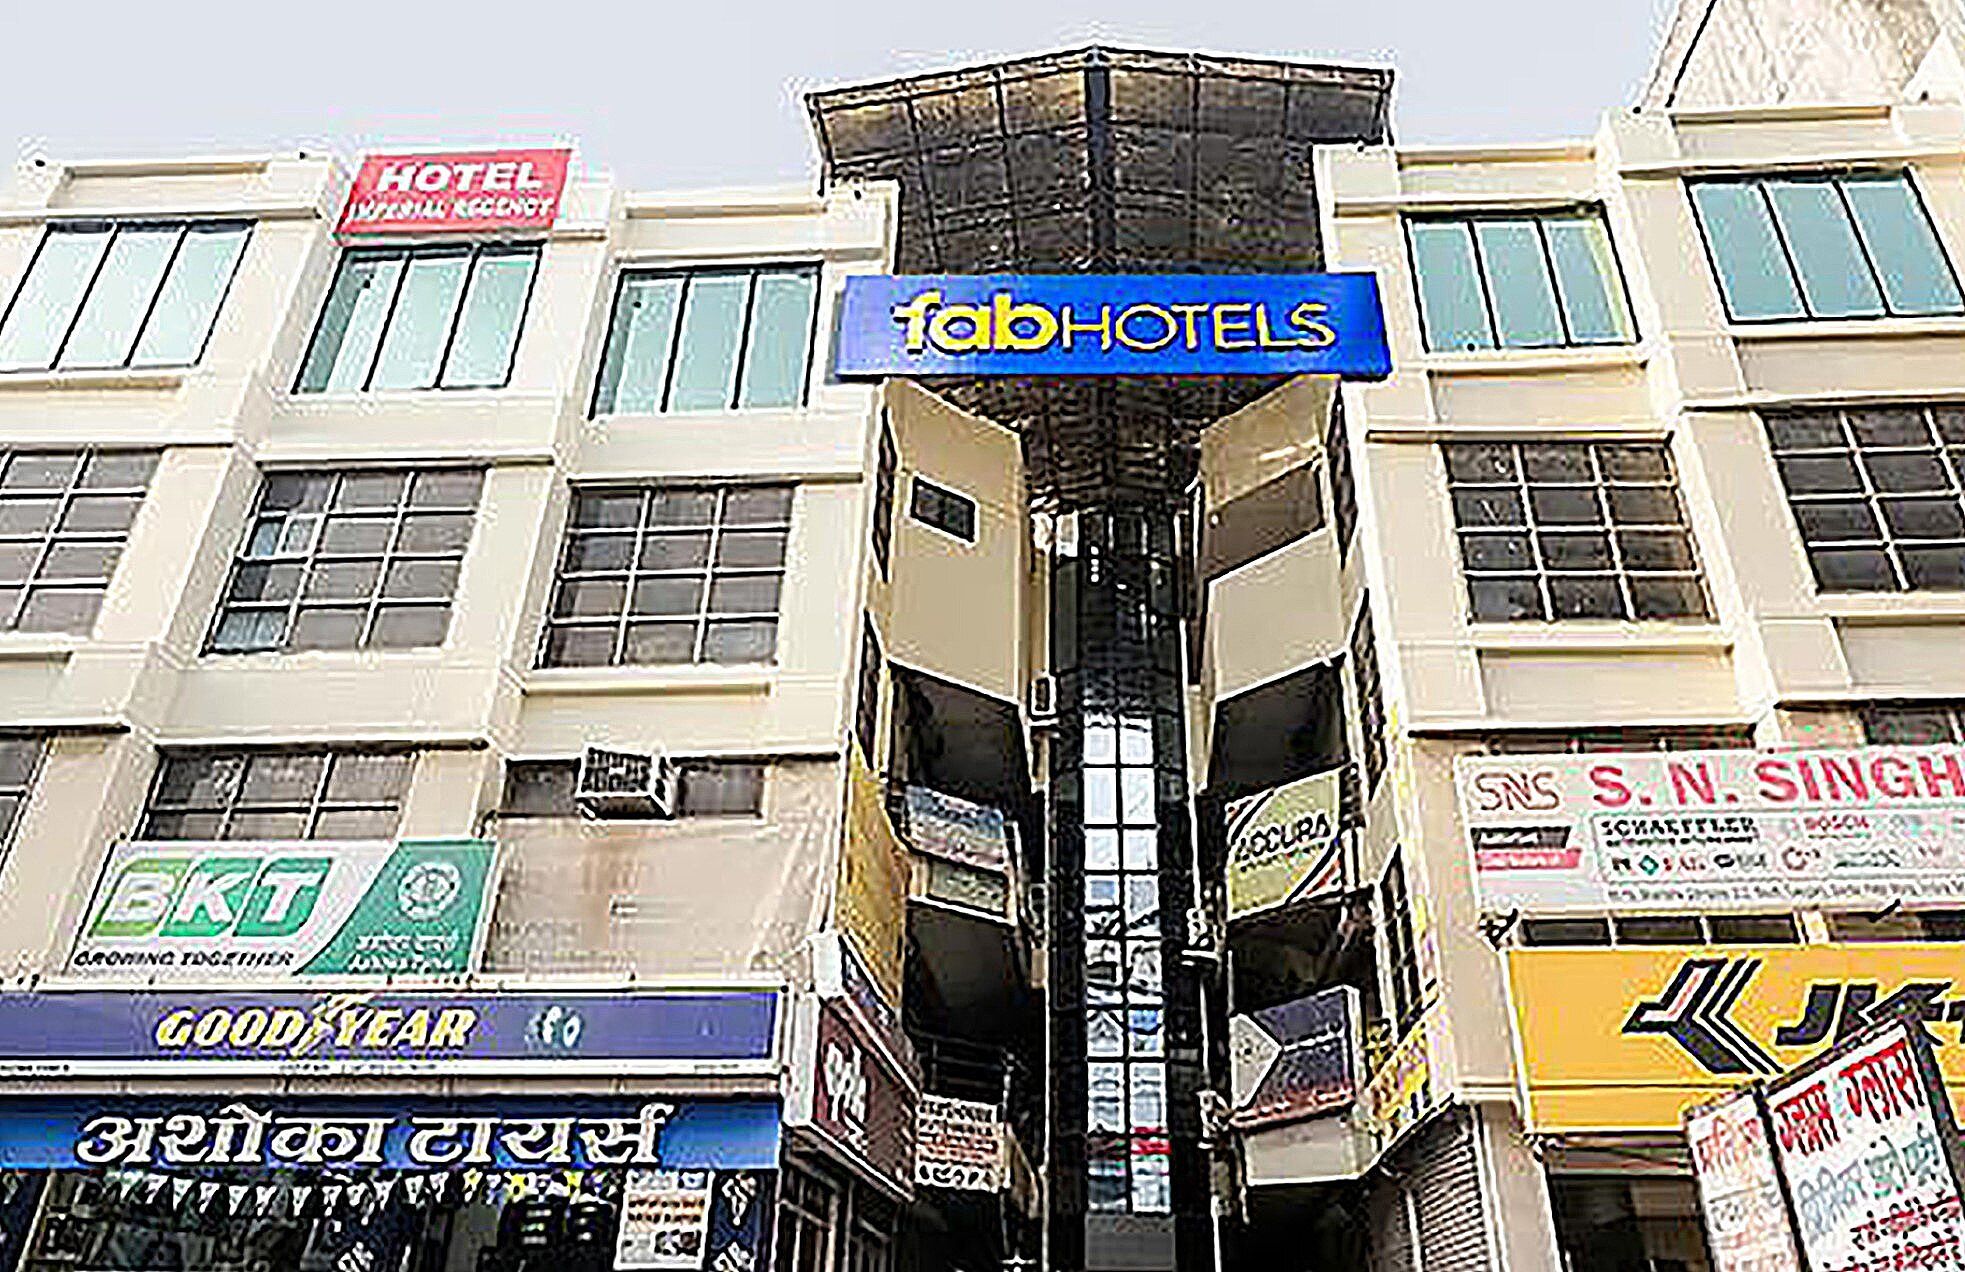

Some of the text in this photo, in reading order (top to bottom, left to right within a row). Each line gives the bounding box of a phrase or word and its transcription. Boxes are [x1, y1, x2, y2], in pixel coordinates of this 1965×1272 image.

[376, 162, 543, 193] HOTEL
[891, 289, 1337, 353] fabHOTELS
[1474, 770, 1562, 811] SNS
[1588, 753, 1965, 807] S. N. SINGH
[98, 867, 325, 927] BKT
[76, 1103, 675, 1163] अशोका टायर्स
